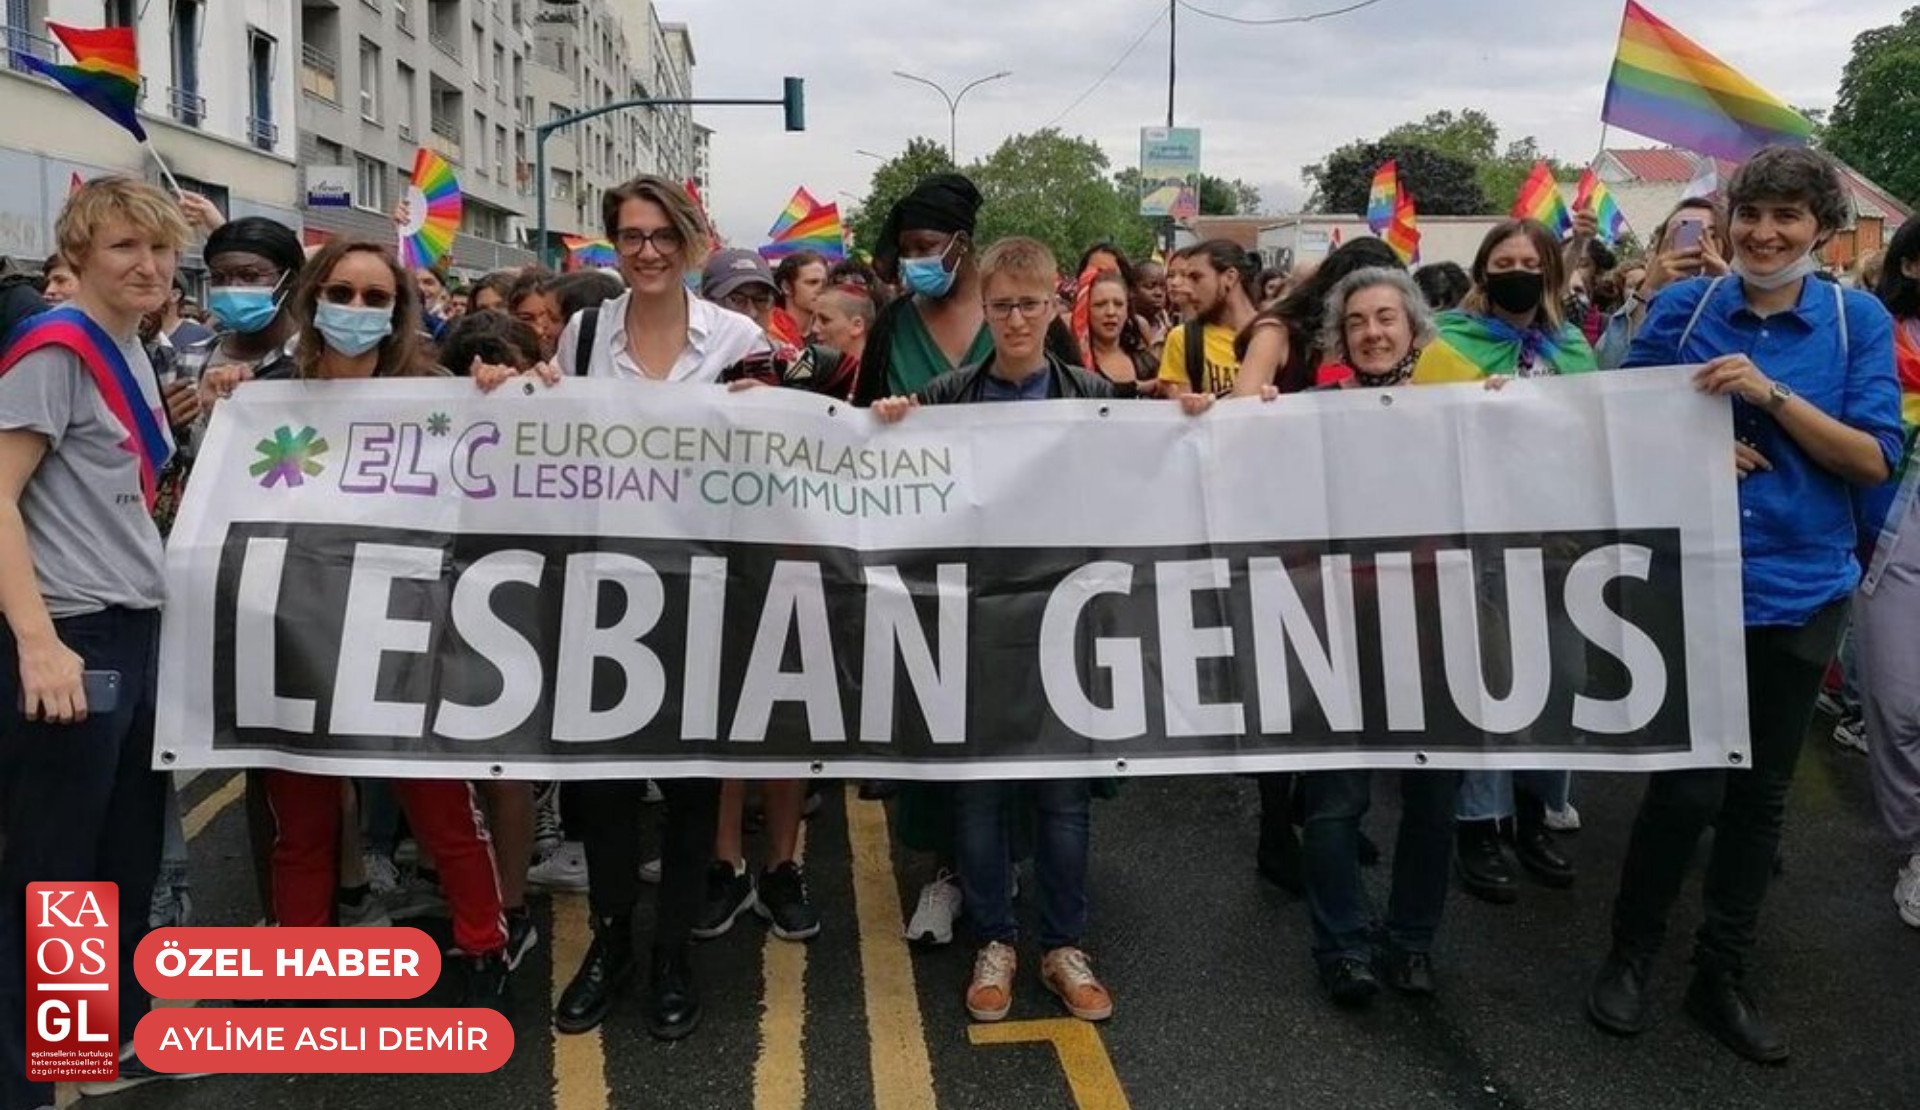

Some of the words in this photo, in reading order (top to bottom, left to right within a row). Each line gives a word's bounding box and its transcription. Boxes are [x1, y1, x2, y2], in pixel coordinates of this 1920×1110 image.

[1208, 359, 1239, 393] HA
[515, 422, 952, 480] EUROCENTRALASIAN
[700, 469, 955, 517] COMMUNITY
[235, 537, 968, 743] LESBIAN
[1039, 543, 1668, 740] GENIUS
